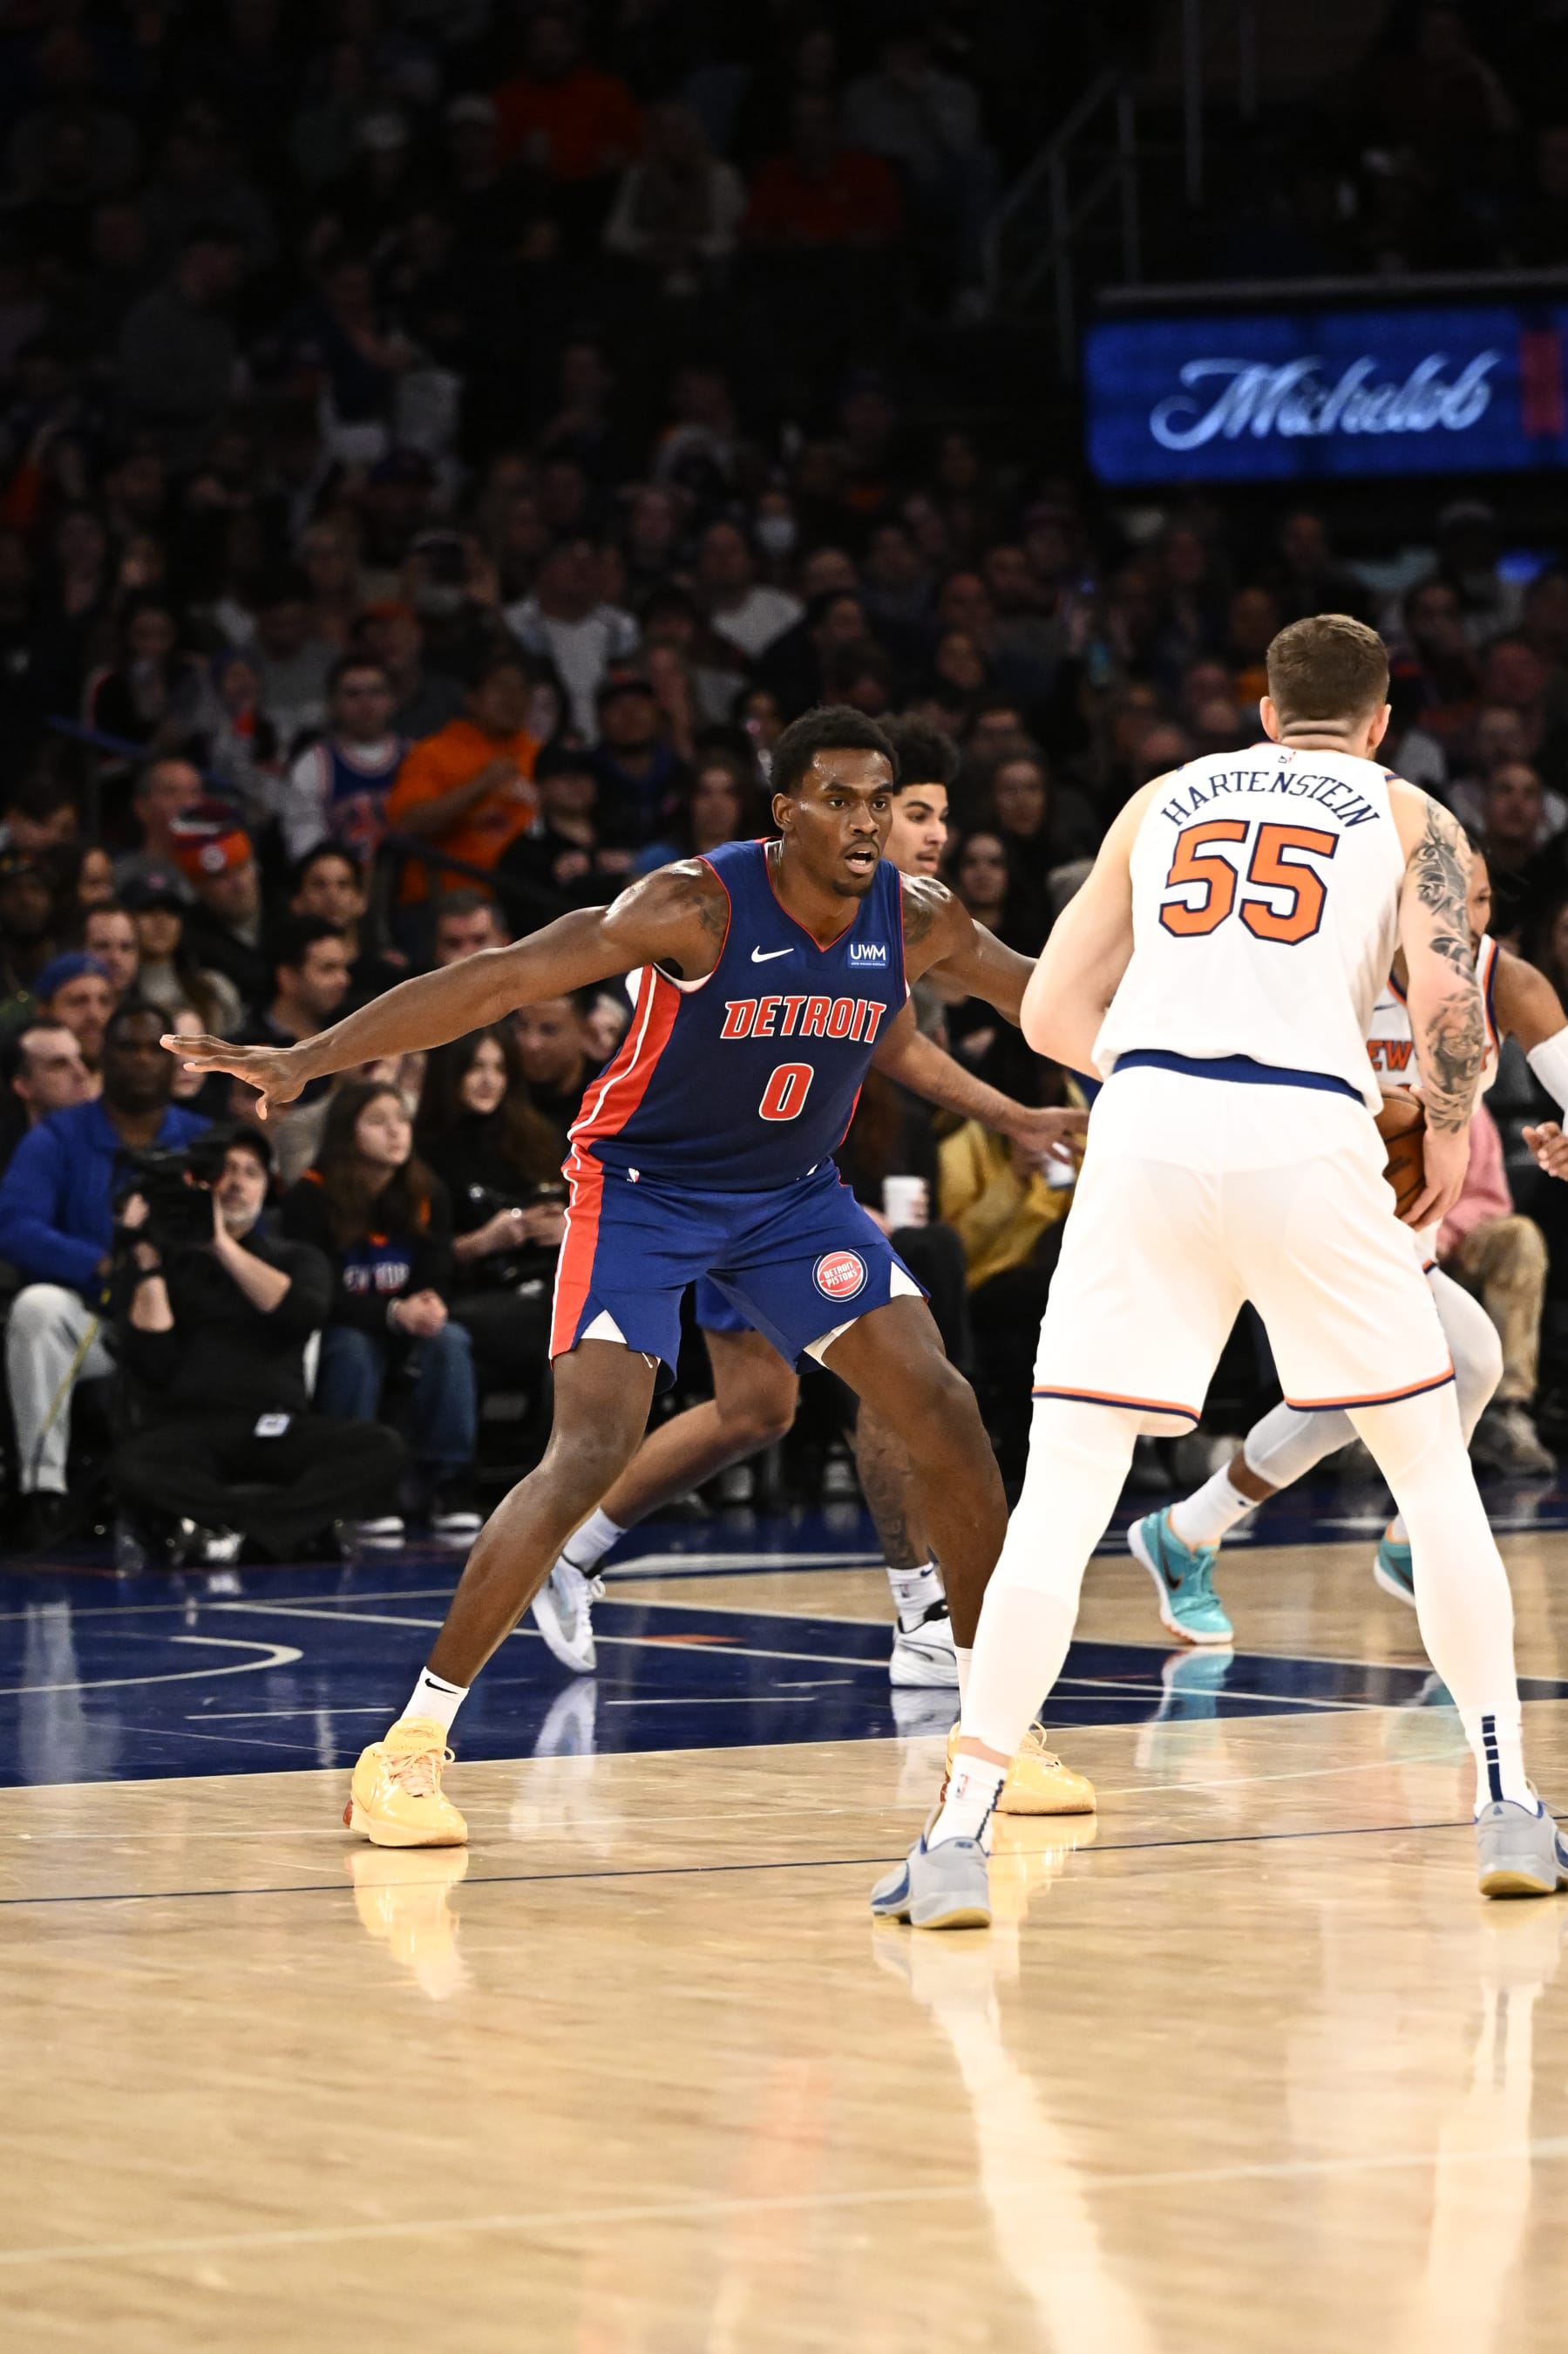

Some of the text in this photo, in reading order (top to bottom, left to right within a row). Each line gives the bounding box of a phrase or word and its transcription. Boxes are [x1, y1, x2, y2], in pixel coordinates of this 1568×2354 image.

[1160, 771, 1380, 827] HARTENSTEIN
[1158, 819, 1340, 946] 55
[850, 943, 886, 961] UWM
[720, 996, 887, 1044] DETROIT
[1367, 1039, 1415, 1072] EW
[758, 1062, 814, 1121] 0
[823, 1261, 854, 1279] DETROIT
[825, 1269, 858, 1288] PISTONS
